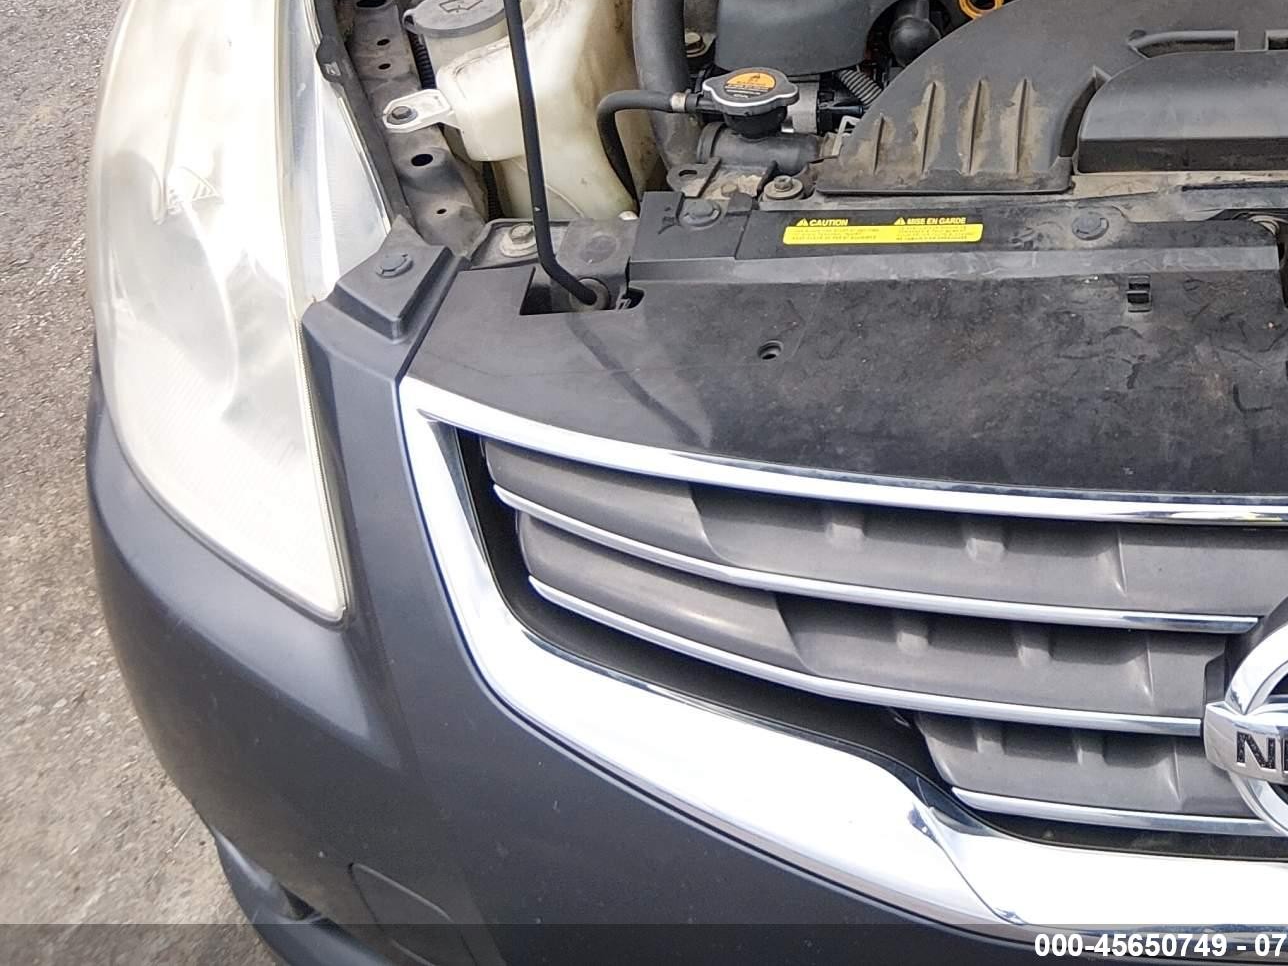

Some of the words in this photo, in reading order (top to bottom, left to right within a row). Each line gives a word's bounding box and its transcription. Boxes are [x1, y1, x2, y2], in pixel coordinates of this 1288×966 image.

[809, 218, 849, 227] CAUTION
[906, 217, 926, 225] MISE
[926, 217, 939, 225] EN
[939, 217, 967, 225] GARDE
